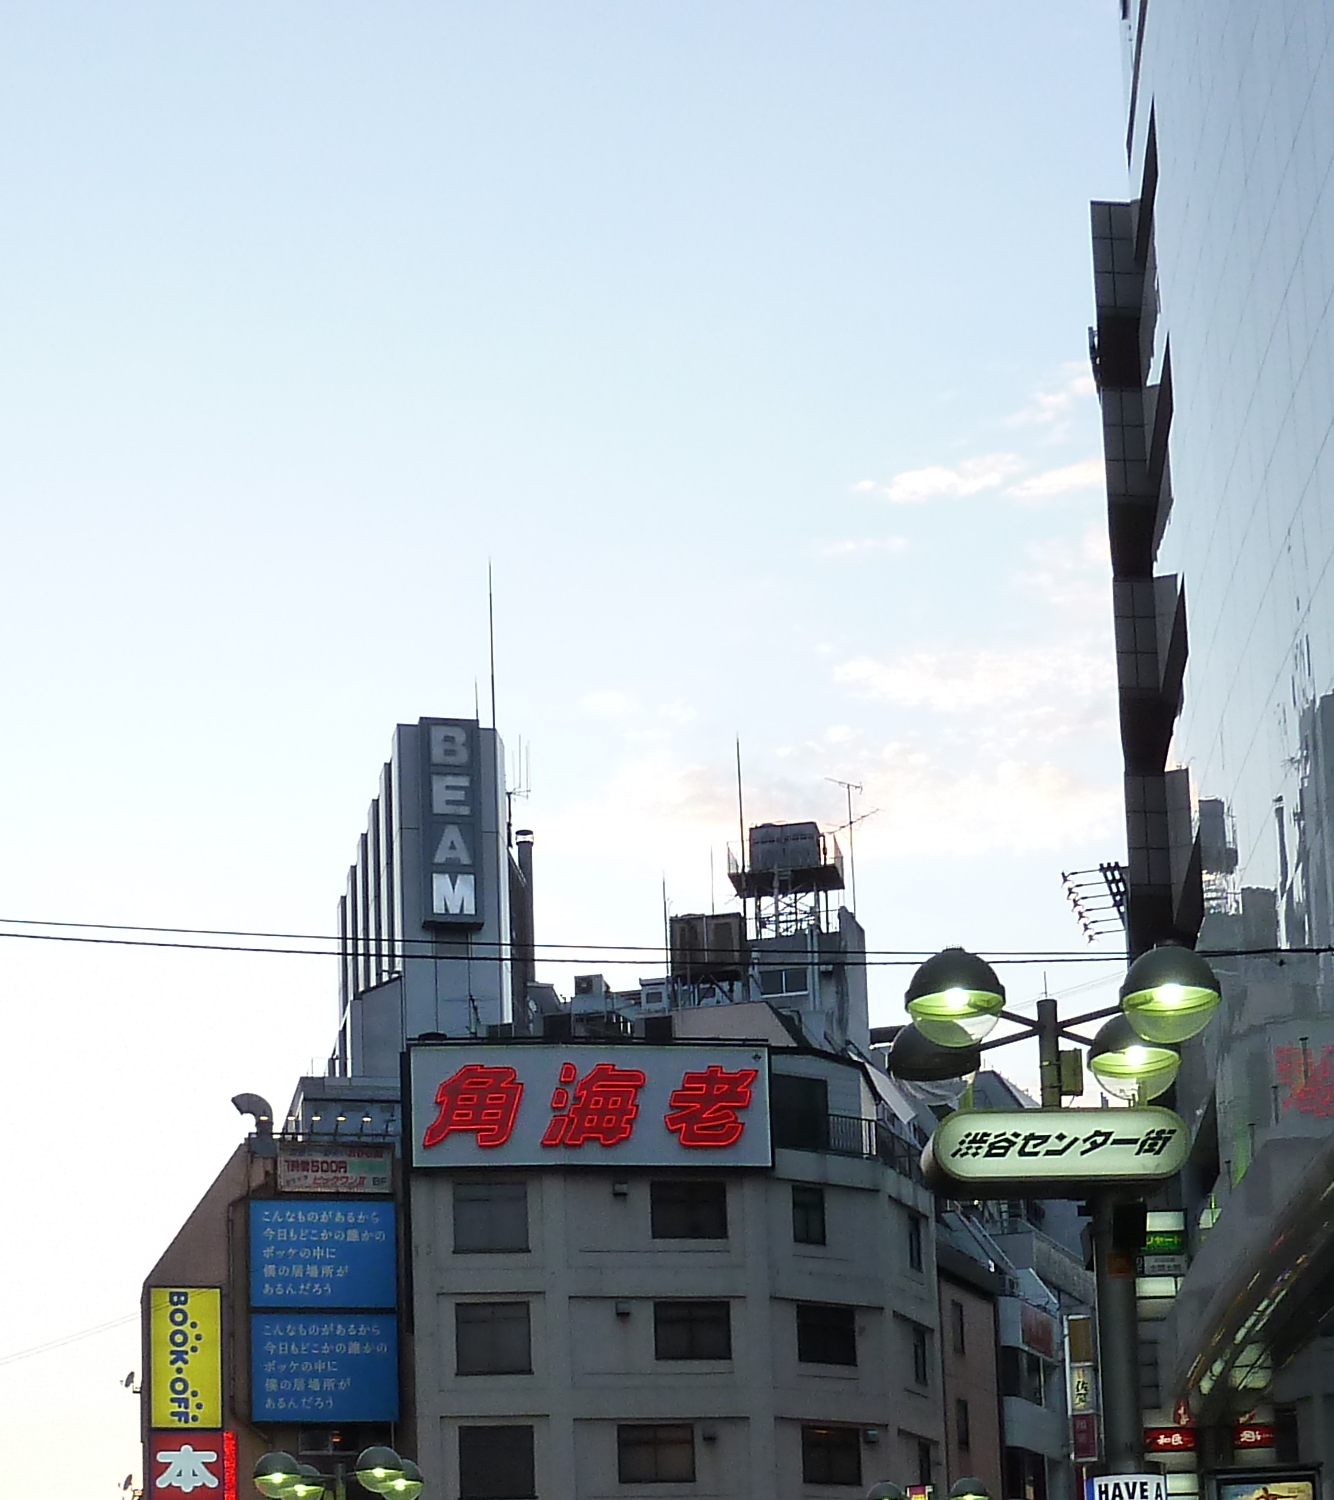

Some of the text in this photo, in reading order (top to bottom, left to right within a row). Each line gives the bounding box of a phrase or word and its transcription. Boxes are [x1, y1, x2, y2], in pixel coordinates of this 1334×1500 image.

[430, 725, 477, 915] BEAM
[423, 1062, 758, 1147] 角海老
[951, 1128, 1178, 1159] 渋谷センター街
[262, 1210, 380, 1224] こんなものがあるから
[262, 1283, 333, 1296] あるんだろう
[156, 1444, 219, 1493] 本
[1155, 1482, 1163, 1500] A
